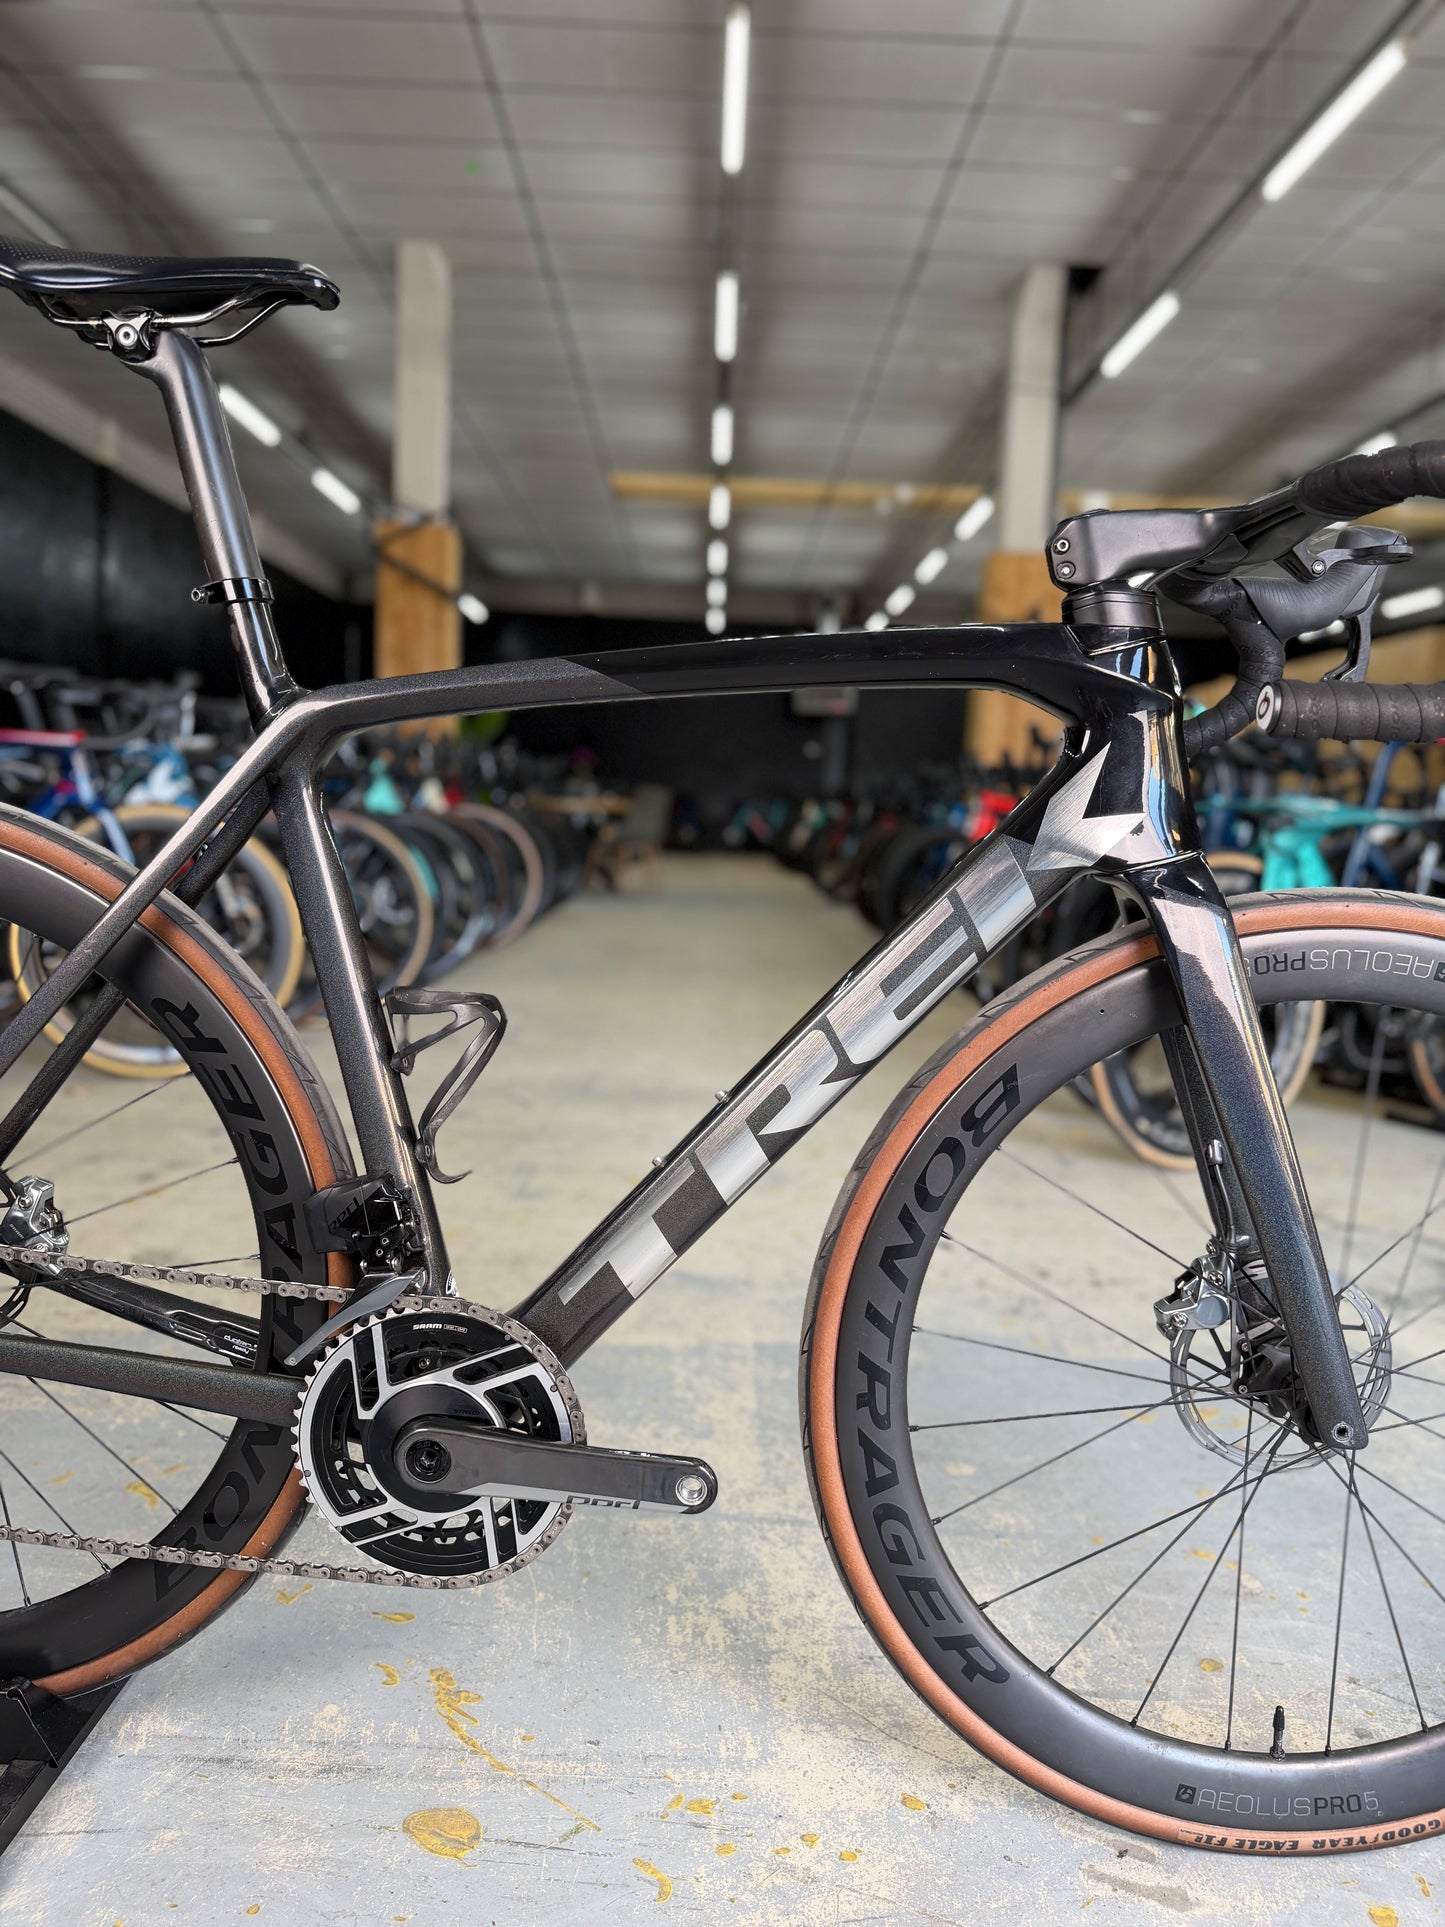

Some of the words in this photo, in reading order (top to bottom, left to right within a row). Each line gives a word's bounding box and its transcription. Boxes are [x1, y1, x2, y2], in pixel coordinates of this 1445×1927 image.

[557, 741, 1147, 1305] TREK
[412, 1323, 443, 1331] SRAM
[855, 1062, 1022, 1685] BONTRAGER
[1231, 1837, 1300, 1851] EAGLE
[1312, 1817, 1442, 1850] GOODYEAR
